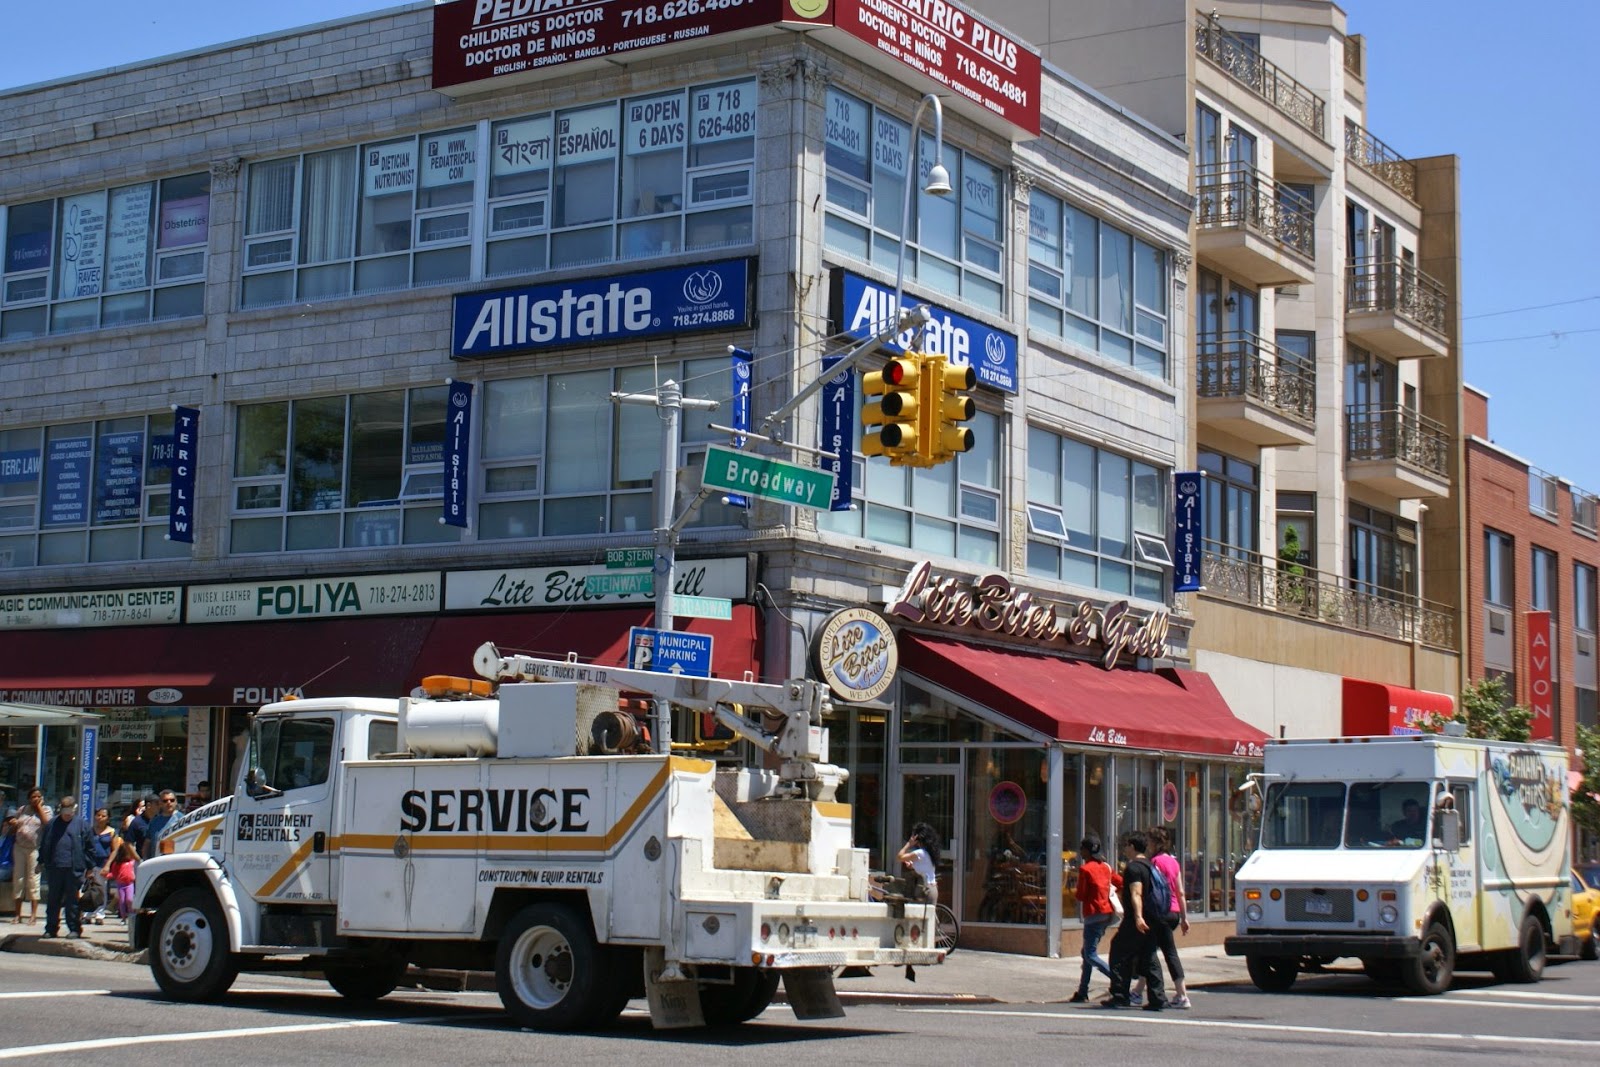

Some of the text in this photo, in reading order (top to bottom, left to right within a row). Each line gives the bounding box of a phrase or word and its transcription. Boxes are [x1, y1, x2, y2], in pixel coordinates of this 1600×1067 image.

[460, 7, 604, 48] CHILDREN'S DOCTOR
[859, 7, 943, 68] DOCTOR DE NIÑOS
[861, 0, 946, 51] ILDREN'S DOCTOR
[465, 28, 596, 66] DOCTOR DE NIÑOS
[494, 25, 710, 75] ENGLISH ESPAÑOL BANGLA PORTUGUESE RUSSIAN
[878, 38, 900, 58] ENGLISH
[971, 22, 1017, 69] PLUS
[956, 53, 1027, 107] 718.626.4881
[644, 100, 681, 124] OPEN
[717, 89, 741, 111] 718
[834, 98, 850, 122] 718
[639, 122, 685, 148] 6 DAYS
[698, 111, 755, 139] 626-4881
[878, 119, 900, 147] OPEN
[501, 135, 551, 166] বাংলা
[559, 126, 617, 156] ESPAÑOL
[381, 152, 410, 171] DIETICIAN
[875, 141, 880, 160] 6
[882, 148, 902, 171] DAYS
[374, 169, 414, 190] NUTRITIONIST
[448, 166, 464, 180] COM
[164, 217, 206, 230] Obstetrics
[462, 283, 652, 350] Allstate
[673, 309, 735, 327] 718.274.8868
[850, 285, 970, 367] Allsate
[22, 456, 41, 474] LAW
[175, 417, 190, 532] TERC LAW
[451, 410, 464, 516] Allstate
[726, 460, 816, 503] Broadway
[1183, 496, 1195, 584] Allstate
[607, 550, 653, 562] BOB STERN
[193, 589, 251, 604] UNISEX LEATHER
[369, 584, 435, 604] 718-274-2813
[481, 574, 534, 605] Lite
[588, 575, 645, 592] STEINWAY
[28, 593, 124, 610] COMMUNICATION
[127, 591, 174, 606] CENTER
[206, 604, 237, 617] JACKETS
[257, 581, 362, 616] FOLIYA
[673, 599, 729, 617] BROADWAY
[92, 608, 151, 621] 718-777-8641
[885, 560, 1170, 670] Lite Bites & Grill
[822, 616, 845, 661] COMPETE
[872, 614, 895, 646] LISTEN
[659, 636, 706, 651] MUNICIPAL
[659, 648, 697, 662] PARKING
[525, 663, 550, 677] SERVICE
[552, 665, 575, 680] TRUCKS
[864, 668, 894, 698] ACHIEVE
[1532, 632, 1550, 718] AVON
[11, 689, 92, 704] COMMUNICATION
[95, 689, 135, 704] CENTER
[1088, 726, 1127, 745] Lite Bites
[84, 732, 93, 771] Steinway
[82, 794, 90, 820] Broad
[400, 788, 590, 833] SERVICE
[255, 814, 313, 828] EQUIPMENT
[254, 828, 300, 842] RENTALS
[478, 870, 604, 885] CONSTRUCTION EQUIP. RENTALS
